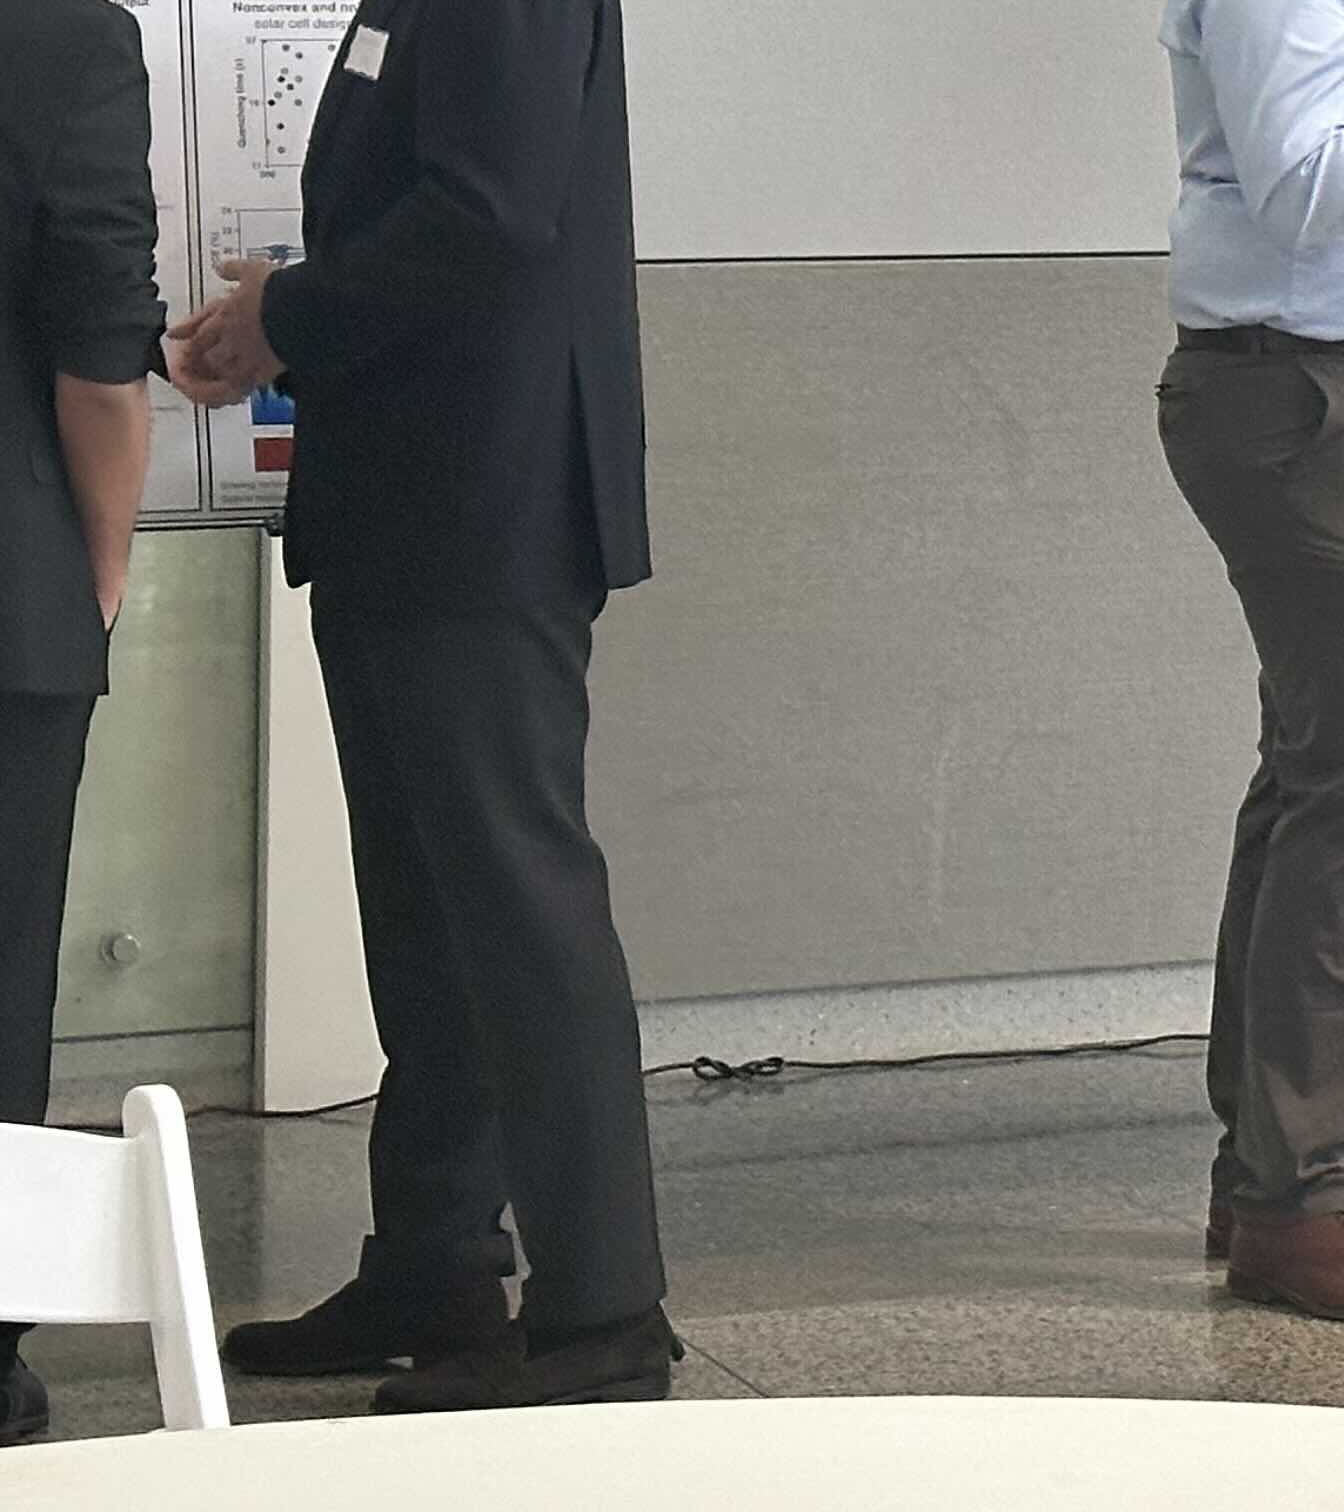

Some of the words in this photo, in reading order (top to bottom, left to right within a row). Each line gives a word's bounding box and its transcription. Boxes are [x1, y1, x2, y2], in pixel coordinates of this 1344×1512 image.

[232, 1, 308, 14] Nonconvex
[312, 2, 336, 14] and
[254, 18, 285, 30] solar
[287, 19, 310, 30] cell
